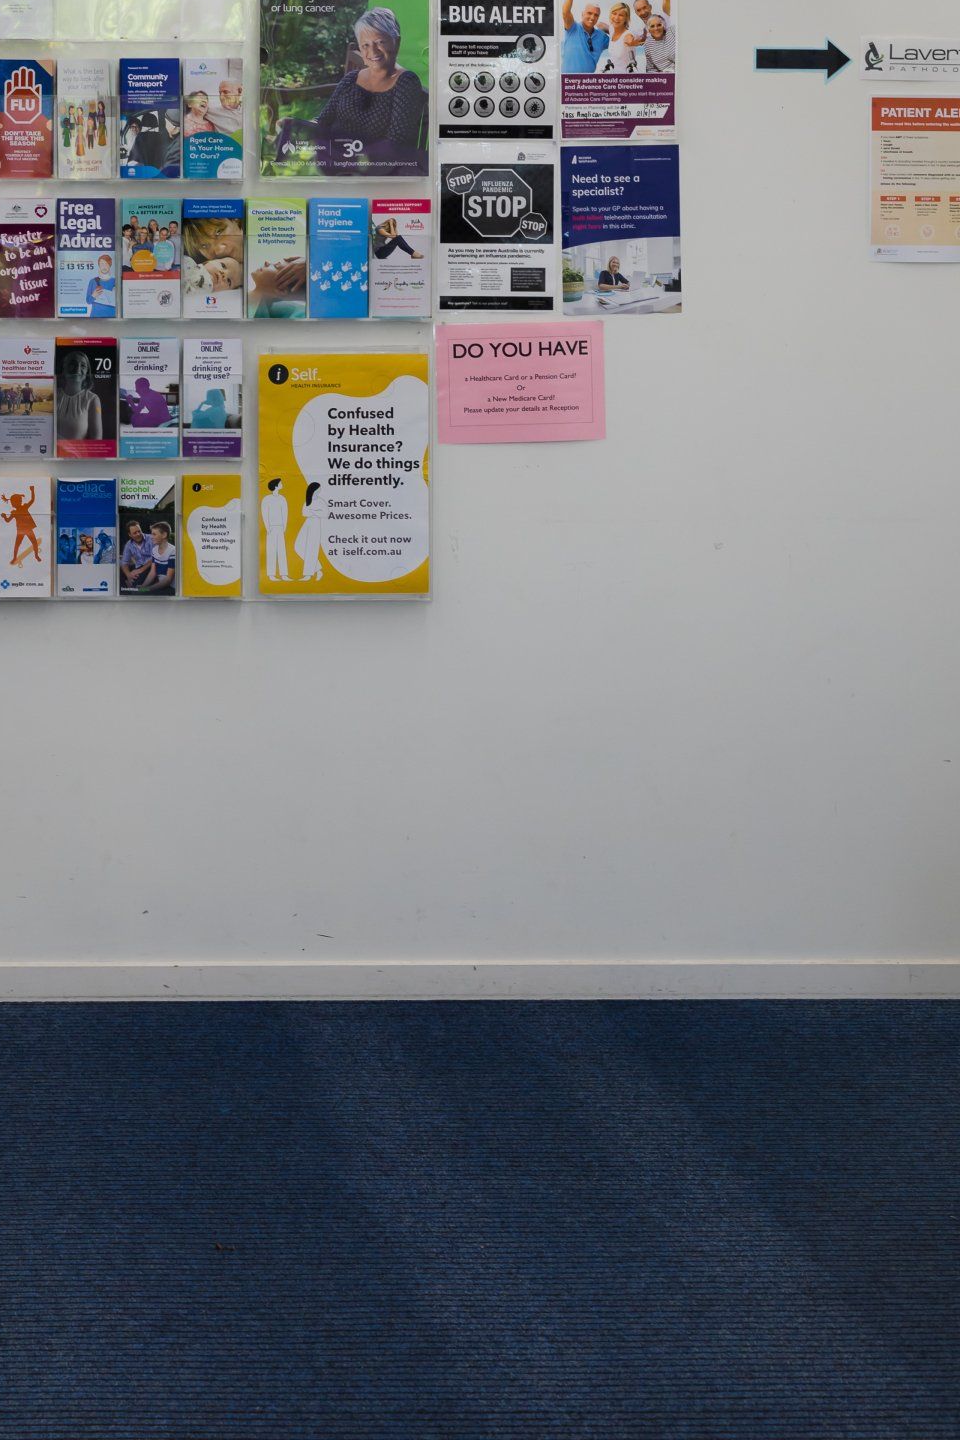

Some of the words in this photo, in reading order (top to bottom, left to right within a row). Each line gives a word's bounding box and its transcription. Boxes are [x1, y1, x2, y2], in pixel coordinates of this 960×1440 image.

[283, 4, 303, 14] lung
[449, 6, 485, 23] BUG
[489, 6, 546, 23] ALERT
[890, 44, 960, 61] Laver
[11, 99, 35, 111] FLU
[881, 108, 931, 117] PATIENT
[935, 108, 960, 118] ALE
[449, 174, 472, 187] STOP
[572, 174, 597, 183] Need
[601, 175, 611, 183] to
[614, 175, 630, 183] see
[572, 187, 624, 198] specialist?
[60, 202, 93, 215] Free
[468, 196, 526, 218] STOP
[61, 216, 101, 232] Legal
[318, 218, 352, 228] Hygiene
[522, 221, 544, 231] STOP
[60, 234, 112, 248] Advice
[453, 343, 483, 358] DO
[489, 342, 532, 357] YOU
[539, 340, 588, 355] HAVE
[95, 358, 111, 370] 70
[328, 407, 394, 419] Confused
[328, 424, 344, 437] by
[349, 424, 394, 436] Health
[328, 441, 402, 452] Insurance?
[328, 458, 350, 469] We
[354, 457, 372, 469] do
[376, 457, 420, 471] things
[328, 474, 404, 488] differently.
[328, 536, 359, 544] Check
[362, 536, 367, 544] it
[371, 536, 387, 544] out
[343, 547, 401, 555] iself.com.au
